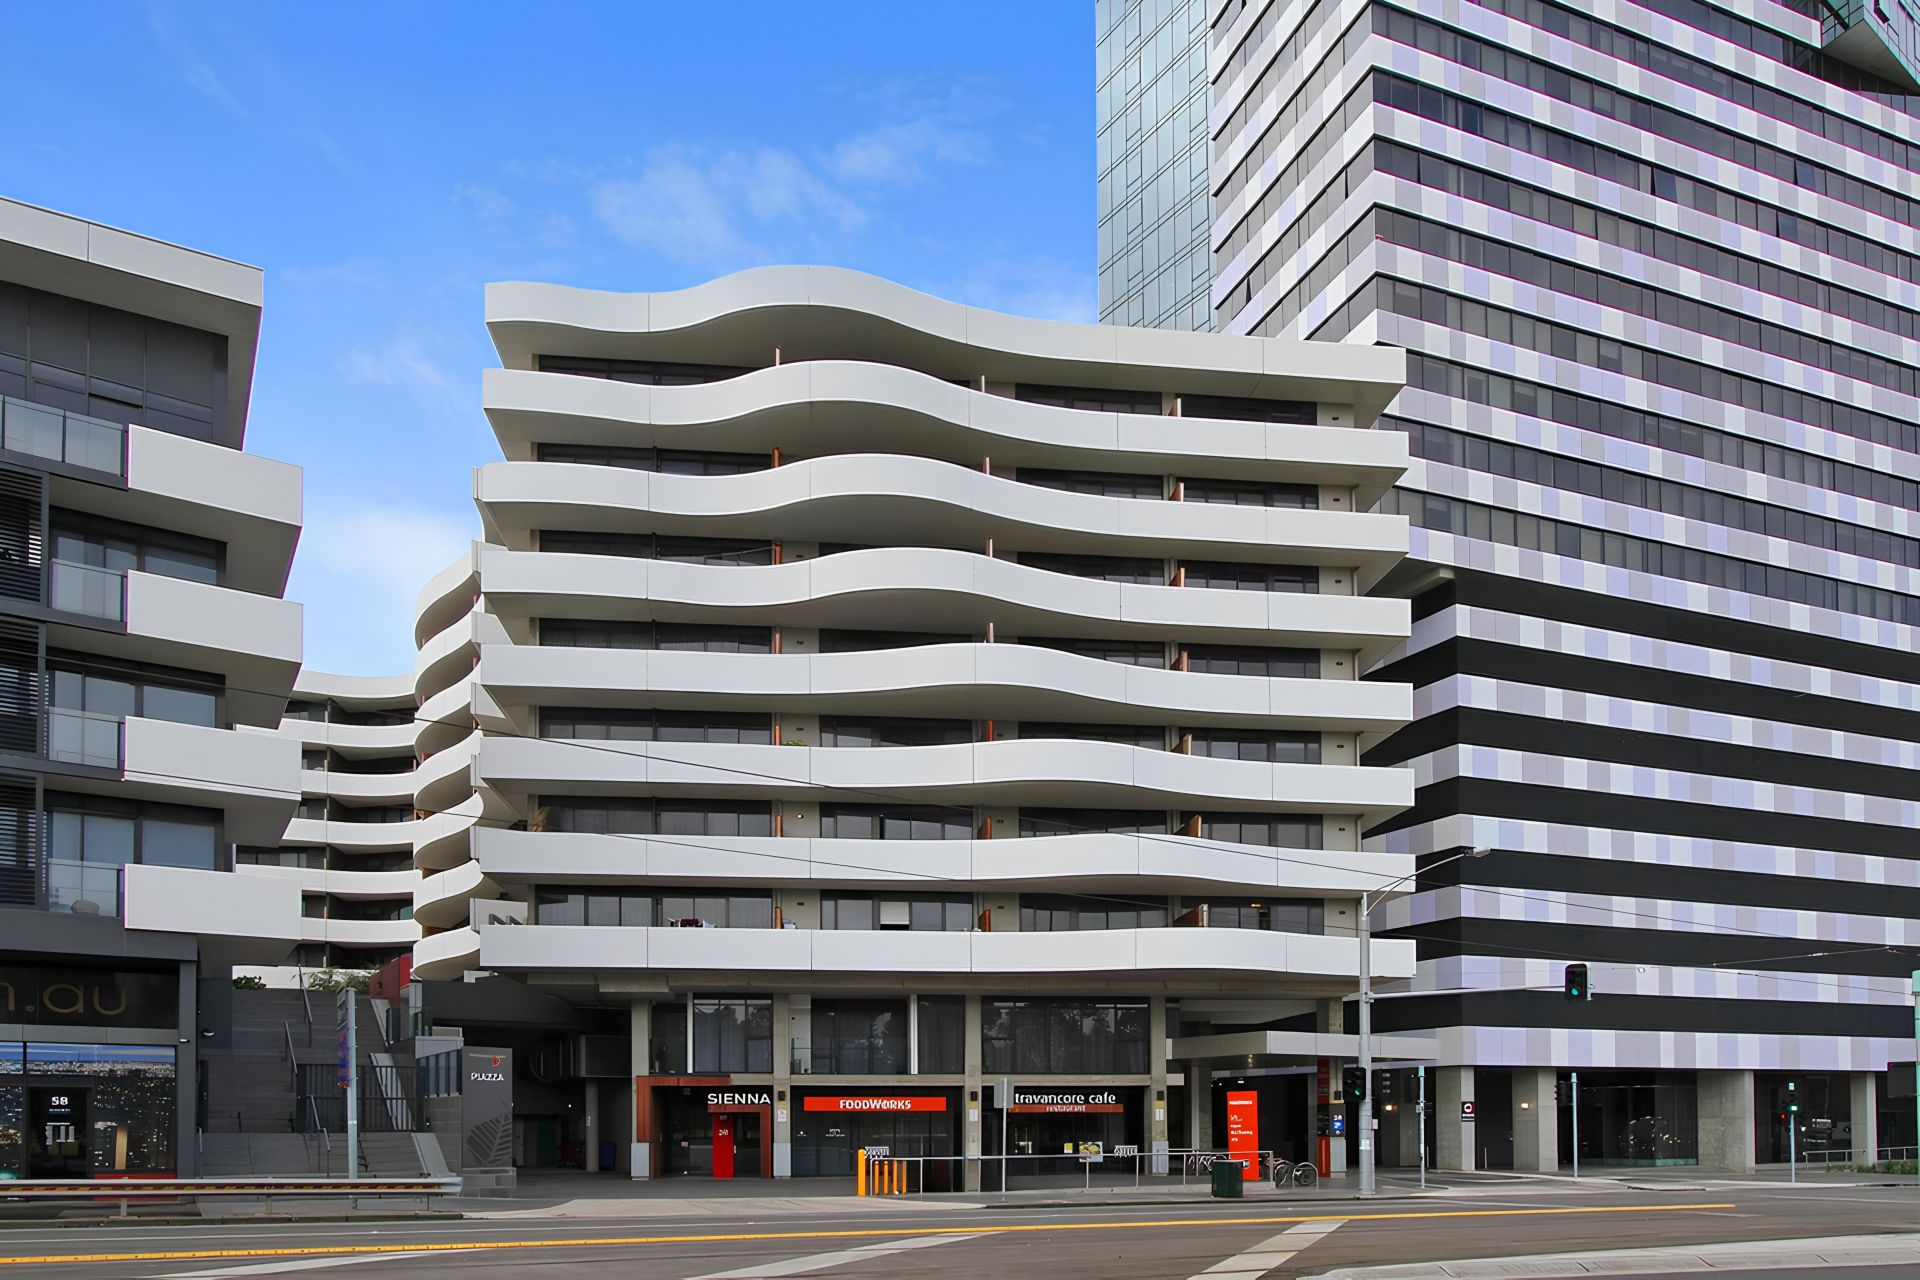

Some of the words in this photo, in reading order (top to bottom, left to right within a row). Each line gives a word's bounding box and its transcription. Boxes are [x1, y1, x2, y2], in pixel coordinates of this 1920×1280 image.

[471, 1072, 504, 1081] PIAZZA
[707, 1093, 771, 1105] SIENNA
[1015, 1093, 1085, 1104] travancore
[1088, 1091, 1116, 1104] cafe
[839, 1099, 912, 1110] FOODWORKS
